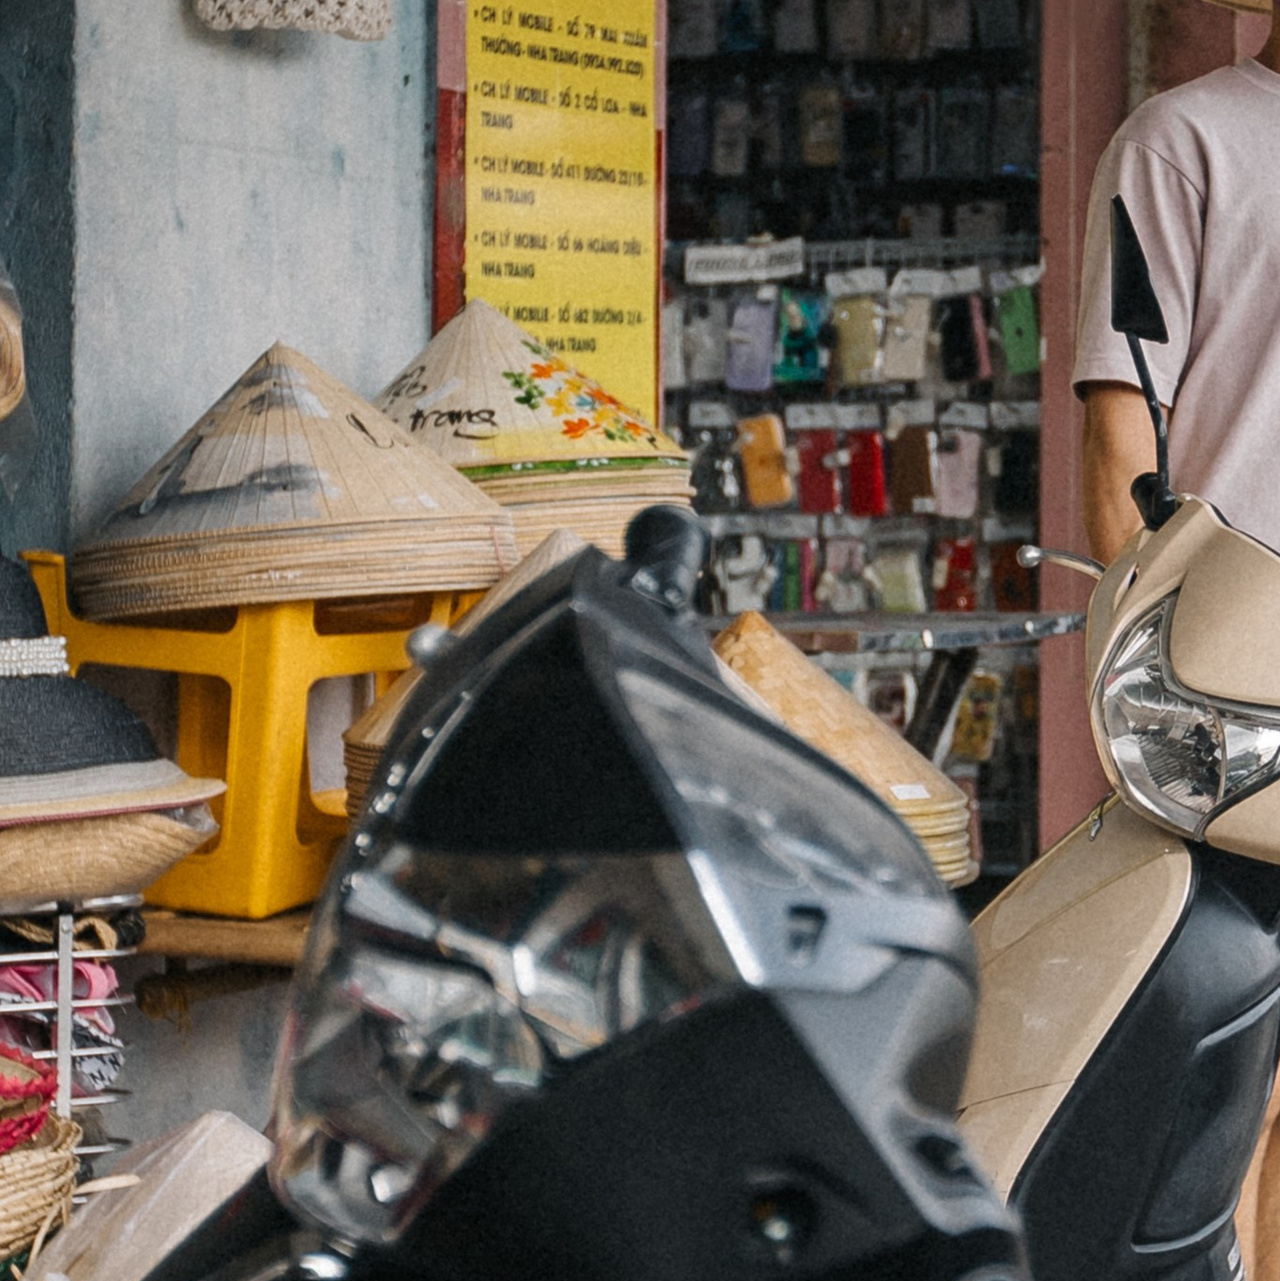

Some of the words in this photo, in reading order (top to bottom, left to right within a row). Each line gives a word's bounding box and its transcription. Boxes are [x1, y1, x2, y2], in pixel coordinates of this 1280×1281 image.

[519, 14, 553, 33] MOBILE
[528, 45, 547, 61] NHA
[551, 48, 579, 66] TRANG
[516, 88, 548, 105] MOBILE
[482, 112, 513, 130] TRANG
[512, 160, 545, 177] MOBILE
[482, 187, 501, 204] NHA
[505, 188, 536, 205] TRANG
[515, 235, 547, 251] MOBILE
[482, 262, 501, 278] NHA
[505, 262, 536, 279] TRANG
[568, 338, 597, 353] TRANG
